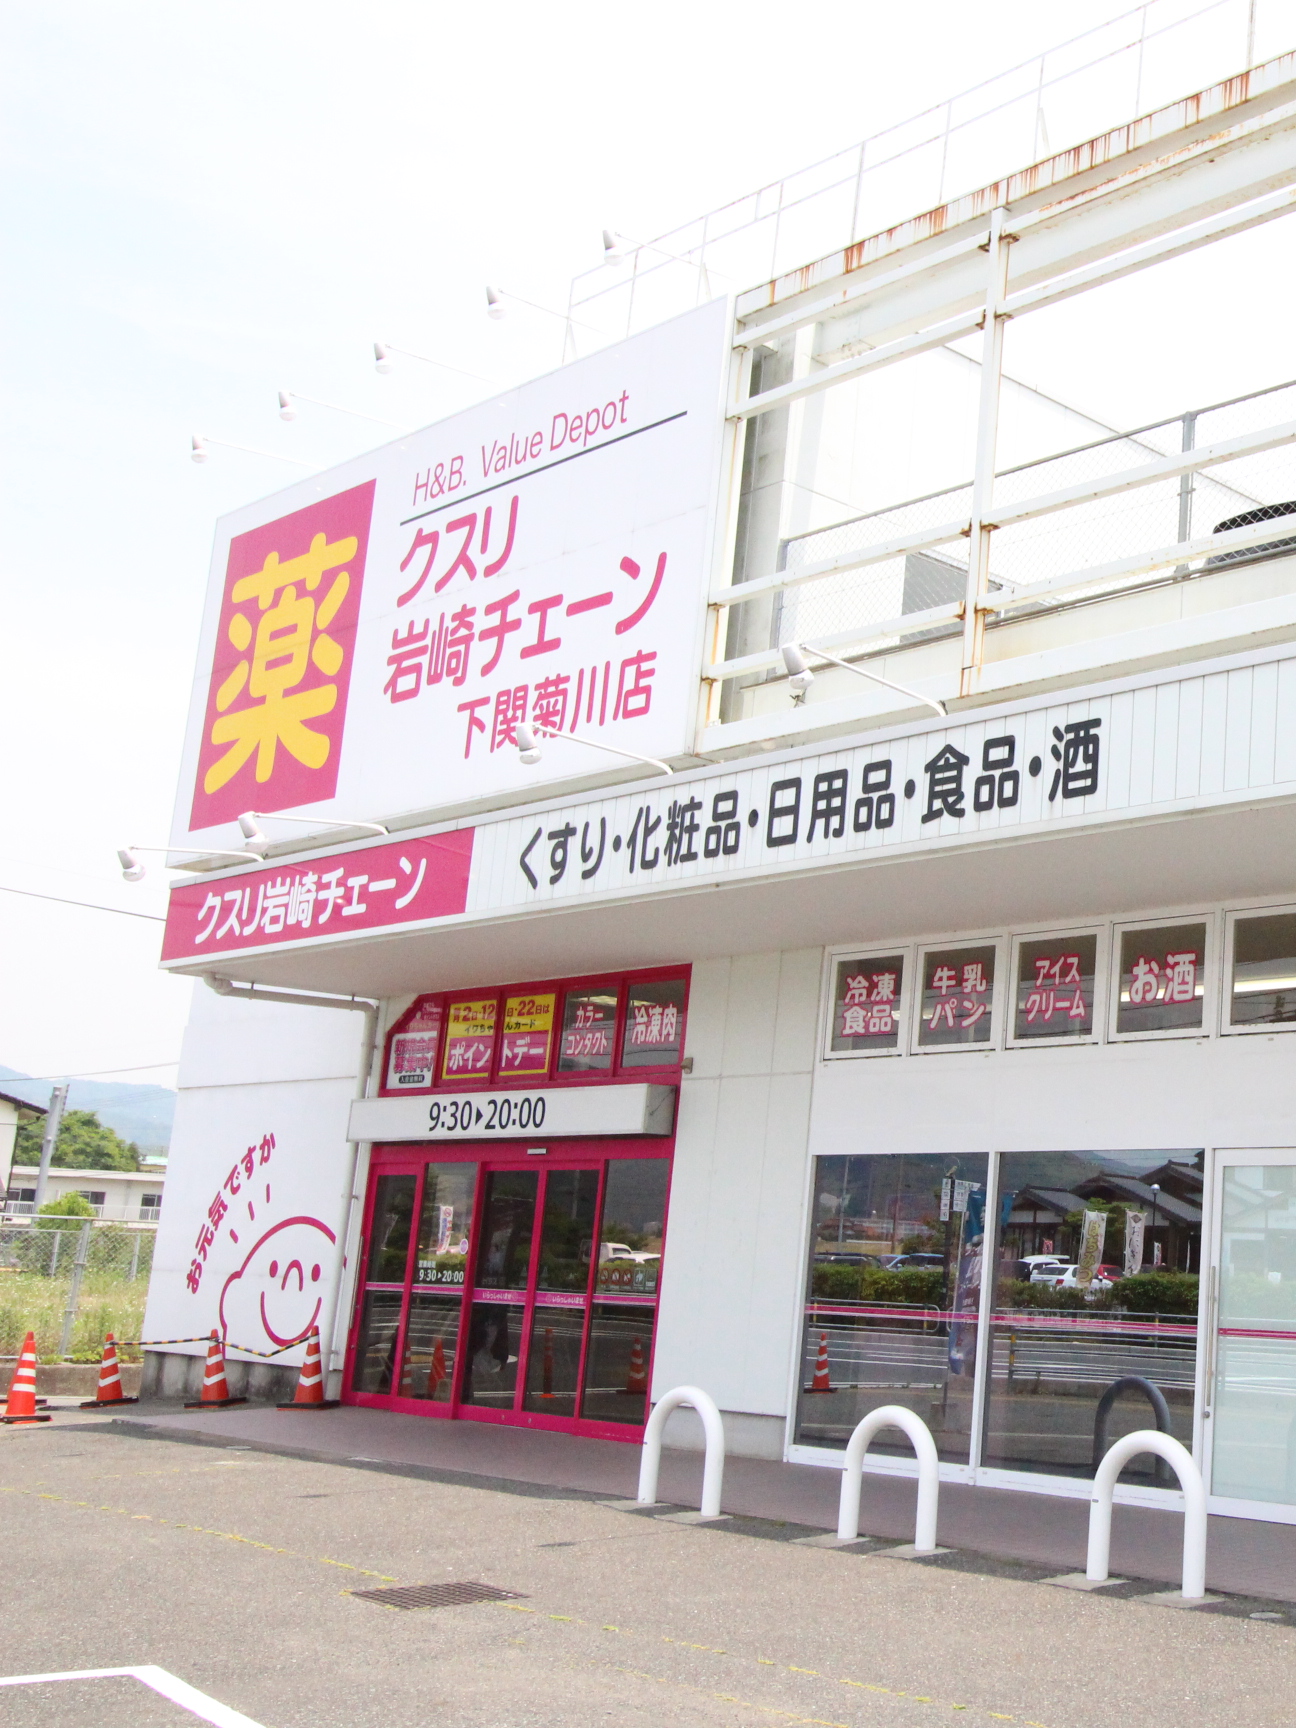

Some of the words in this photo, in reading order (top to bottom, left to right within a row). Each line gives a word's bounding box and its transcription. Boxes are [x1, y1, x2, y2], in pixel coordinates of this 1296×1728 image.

[413, 455, 466, 506] H&B.
[481, 431, 543, 478] Value
[550, 390, 629, 447] Depot
[397, 495, 519, 608] クスリ
[383, 551, 667, 704] 岩崎チェーン
[204, 532, 358, 795] 薬
[457, 649, 657, 759] 下関菊川店
[195, 857, 426, 944] クスリ岩崎チェーン
[845, 973, 896, 1004] 冷凍
[933, 963, 986, 995] 牛乳
[1035, 956, 1080, 987] アイス
[1131, 953, 1196, 1003] お酒
[576, 1005, 604, 1029] カラー
[843, 1005, 892, 1035] 食品
[930, 999, 985, 1029] パン
[1026, 990, 1085, 1021] クリーム
[632, 1003, 677, 1044] 冷凍肉
[566, 1030, 608, 1055] コンタクト
[429, 1101, 472, 1132] 9:30
[484, 1097, 546, 1130] 20:00
[187, 1133, 275, 1294] お元気ですか
[419, 1269, 436, 1281] 9:30
[442, 1270, 464, 1282] 20:00
